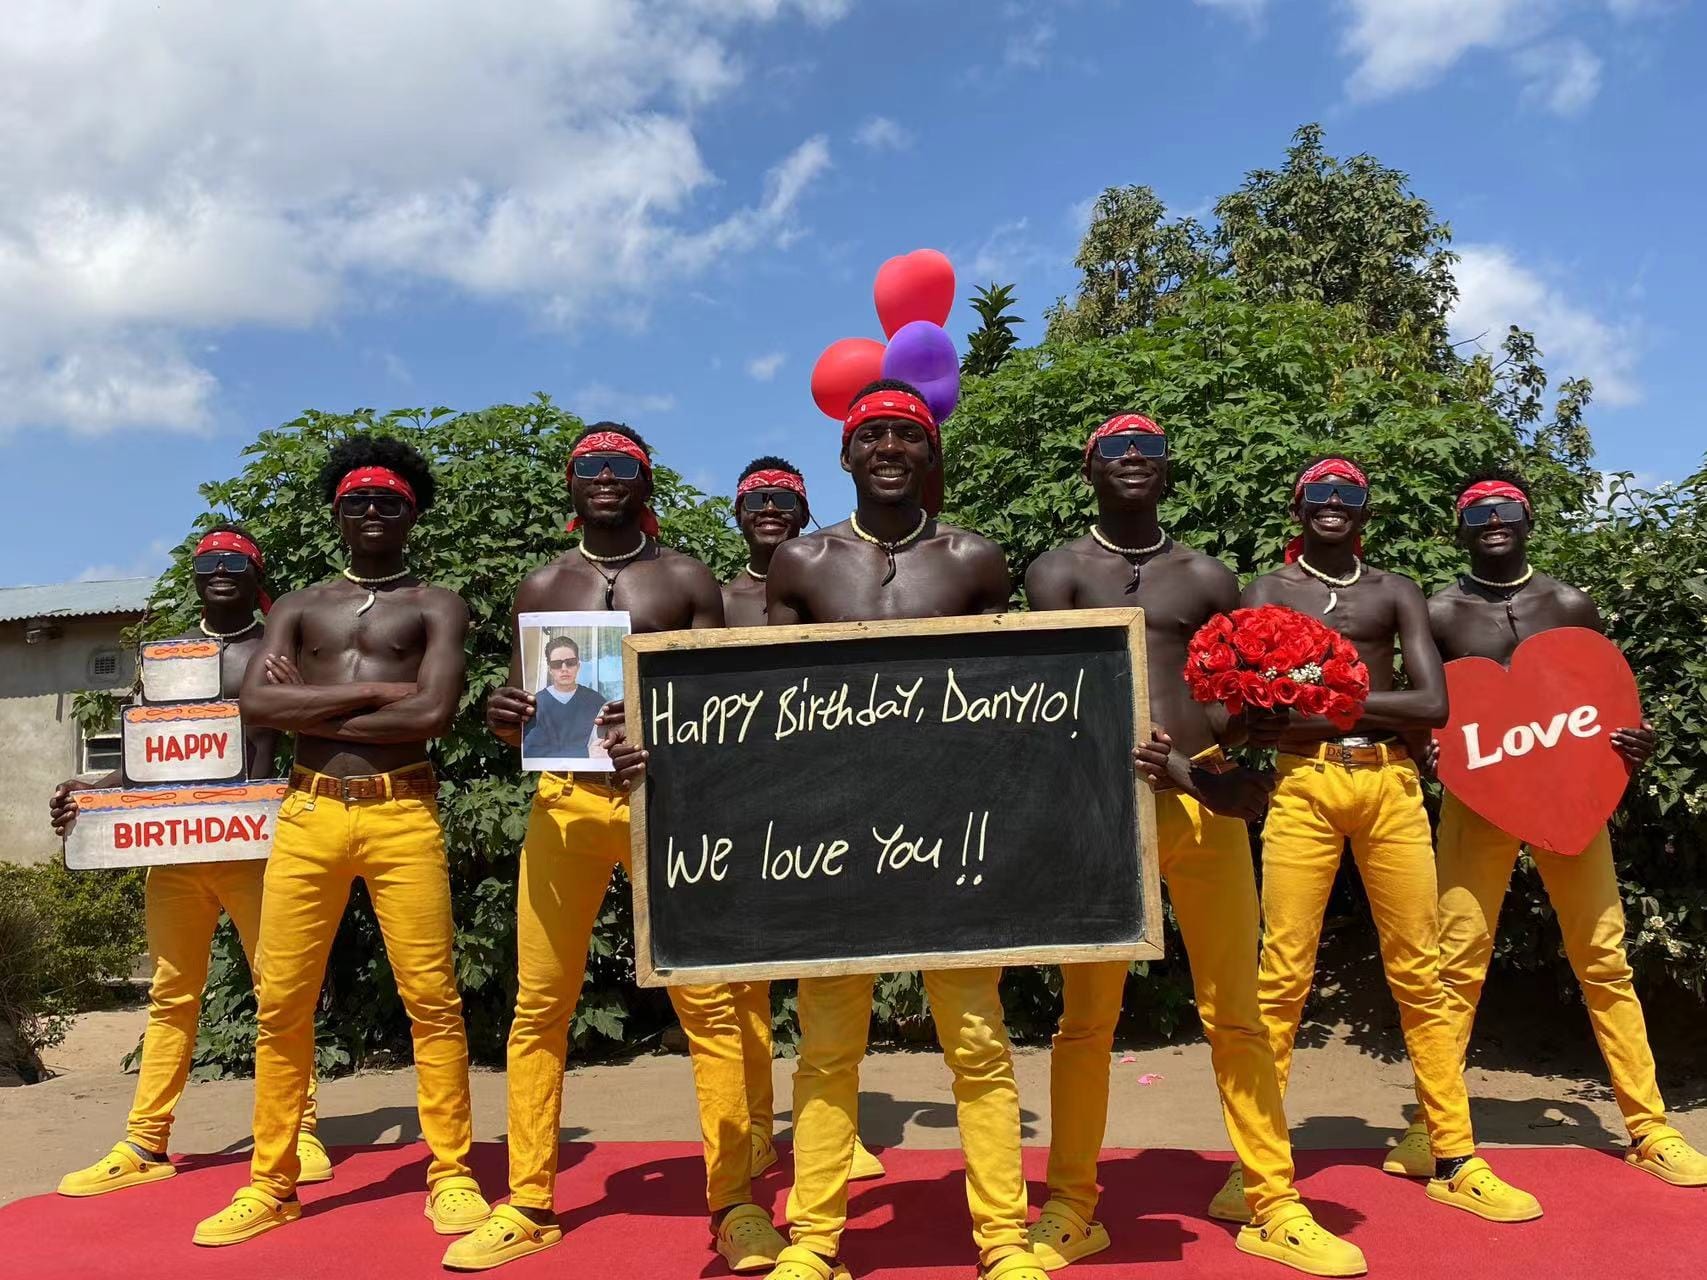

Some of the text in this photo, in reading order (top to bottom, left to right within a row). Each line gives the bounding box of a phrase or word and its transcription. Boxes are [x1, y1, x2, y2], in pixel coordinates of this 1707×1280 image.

[652, 667, 1084, 746] Happy Birthday, Danylo!
[1461, 705, 1602, 770] Love
[145, 733, 228, 763] HAPPY
[113, 815, 269, 850] BIRTHDAY.
[667, 834, 733, 889] We
[761, 820, 850, 881] love
